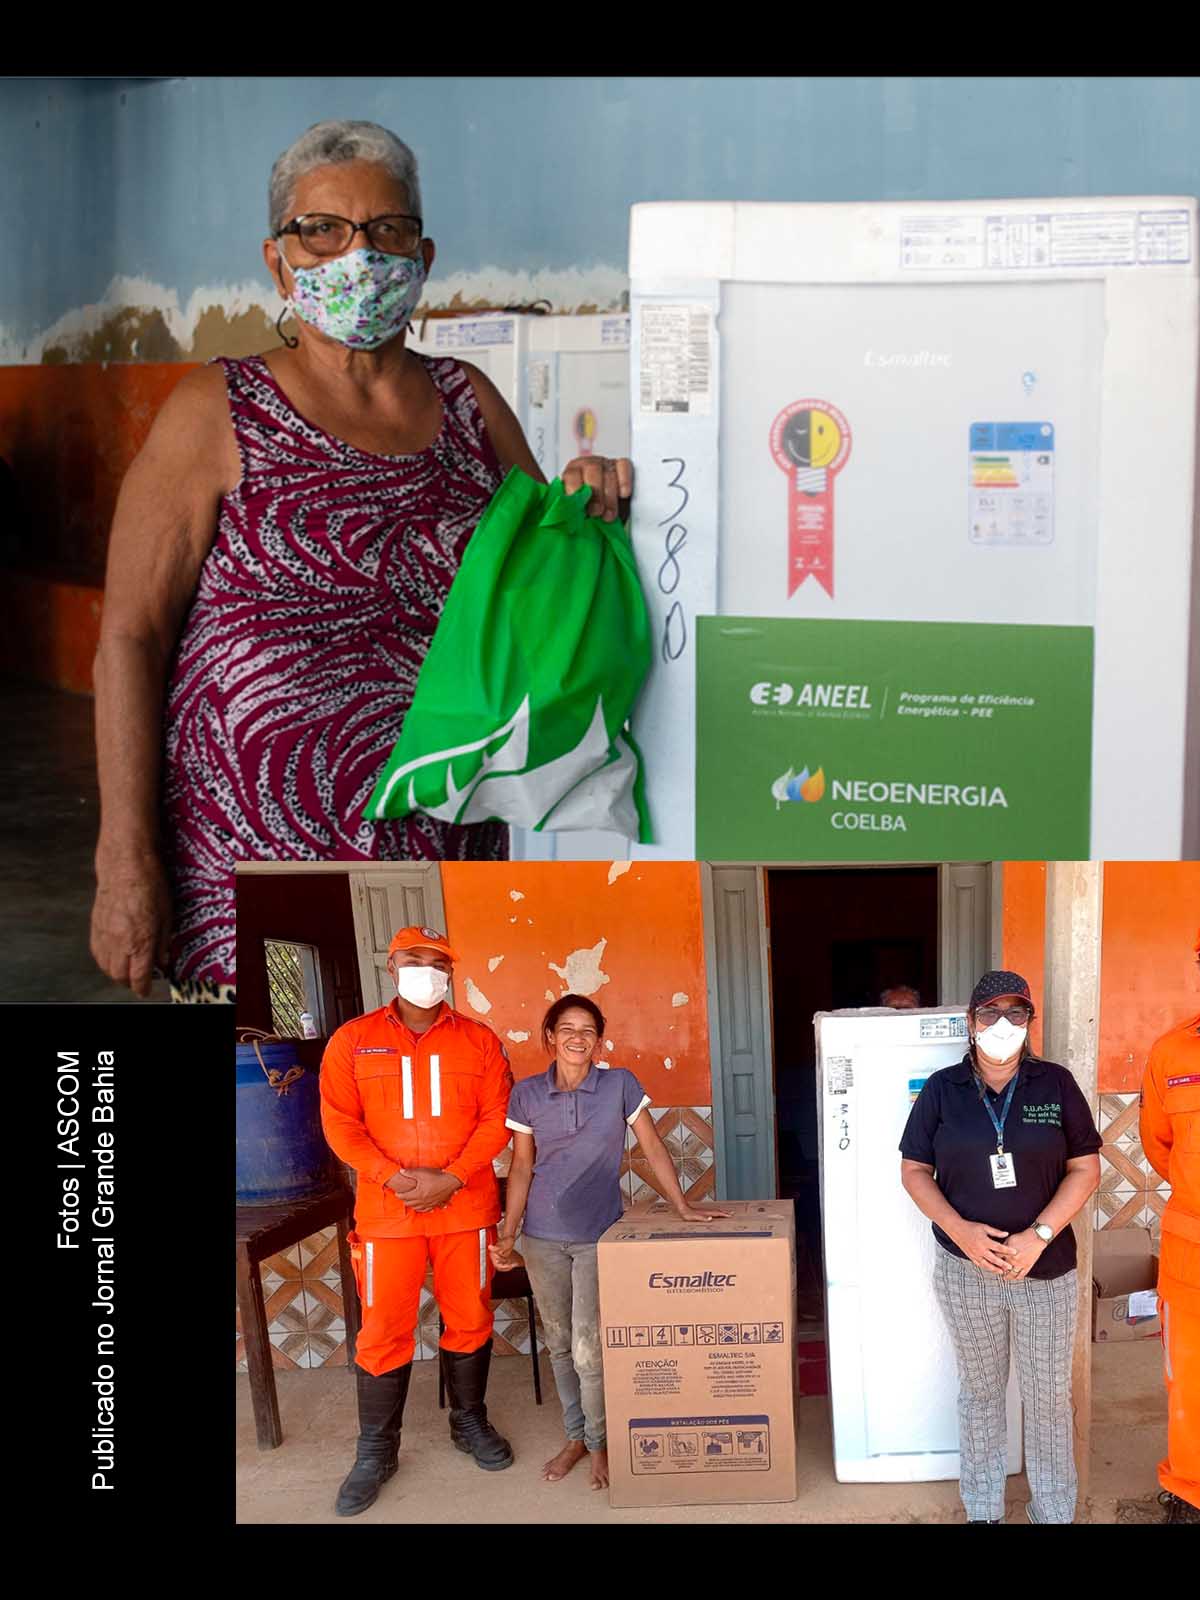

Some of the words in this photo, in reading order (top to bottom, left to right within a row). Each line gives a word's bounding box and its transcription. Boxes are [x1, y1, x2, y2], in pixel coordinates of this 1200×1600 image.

[797, 684, 872, 709] ANEEL
[900, 692, 957, 704] Programa
[960, 694, 976, 704] de
[977, 695, 1035, 706] Eficiência
[897, 705, 960, 717] Energética
[970, 707, 994, 718] PEE
[831, 780, 1009, 808] NEOENERGIA
[831, 812, 907, 832] COELBA
[648, 1271, 737, 1289] Esmaltec
[635, 1359, 678, 1369] ATENÇÃO!
